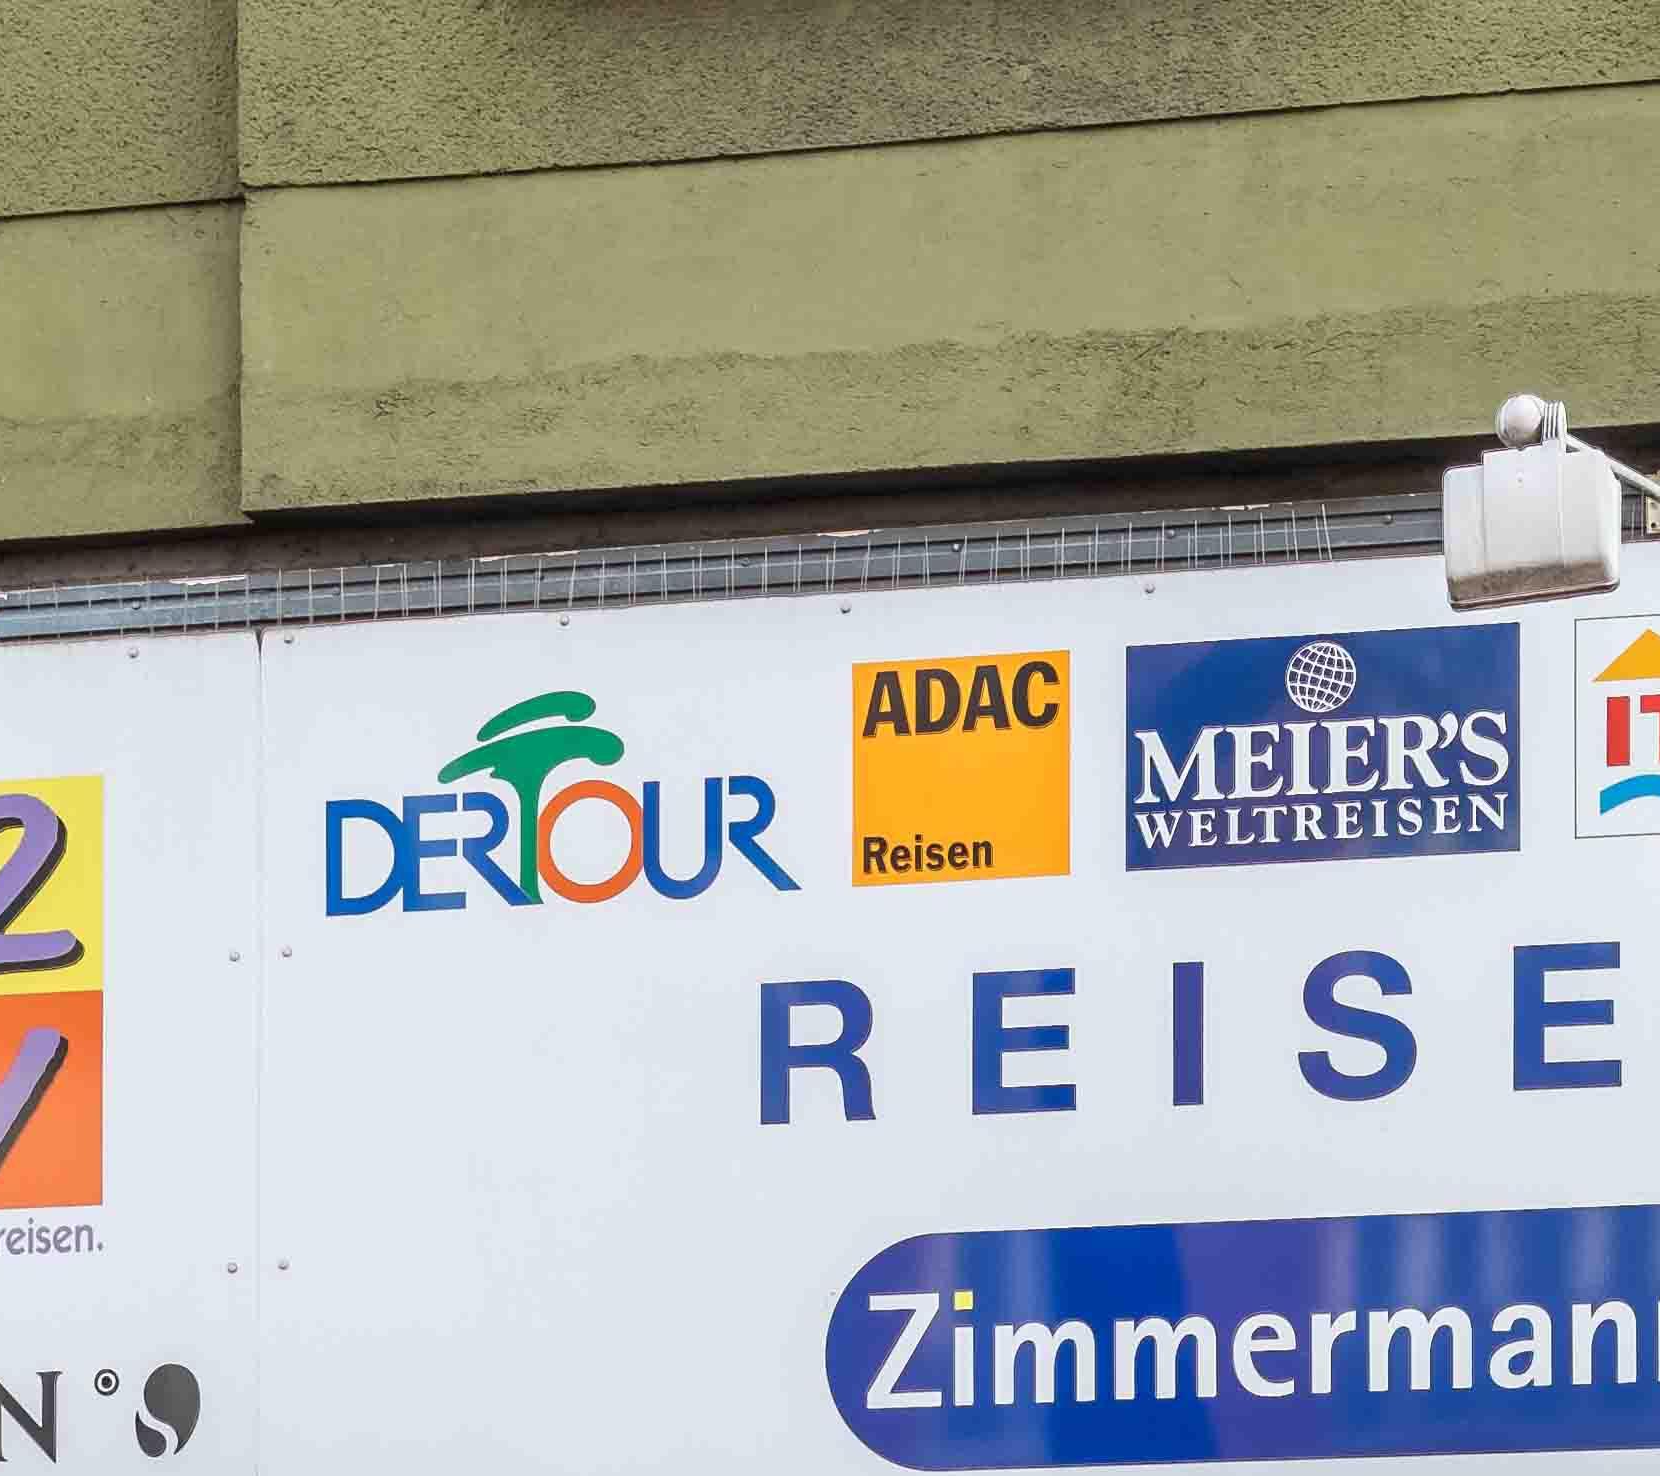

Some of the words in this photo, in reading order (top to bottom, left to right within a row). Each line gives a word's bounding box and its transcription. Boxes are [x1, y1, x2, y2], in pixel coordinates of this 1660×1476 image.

[862, 661, 1061, 740] ADAC
[1135, 708, 1509, 801] MEIER'S
[326, 735, 801, 917] DERTOUR
[862, 833, 993, 874] Reisen
[1134, 792, 1507, 851] WELTREISEN
